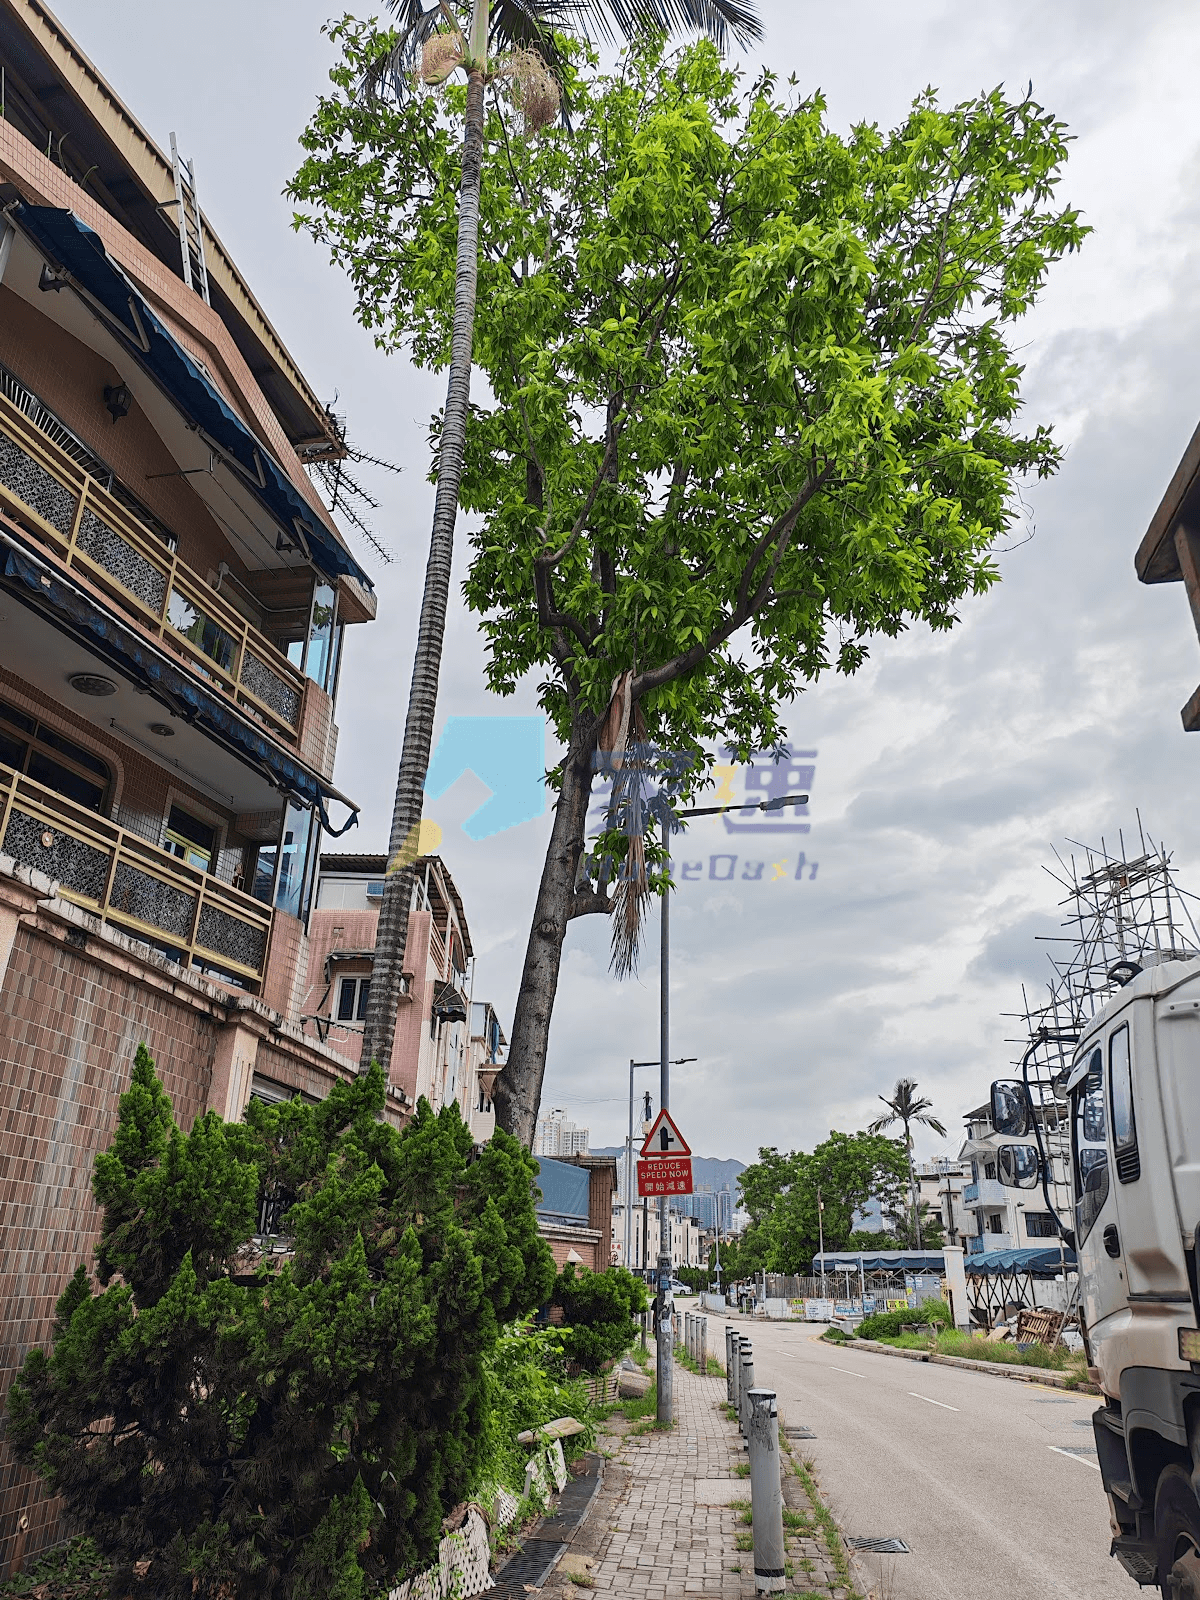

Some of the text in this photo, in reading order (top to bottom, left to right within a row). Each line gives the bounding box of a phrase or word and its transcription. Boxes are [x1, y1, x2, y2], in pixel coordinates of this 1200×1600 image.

[648, 1162, 680, 1170] REDUCE
[669, 1170, 689, 1178] NOW
[645, 1181, 686, 1191] 開始減速
